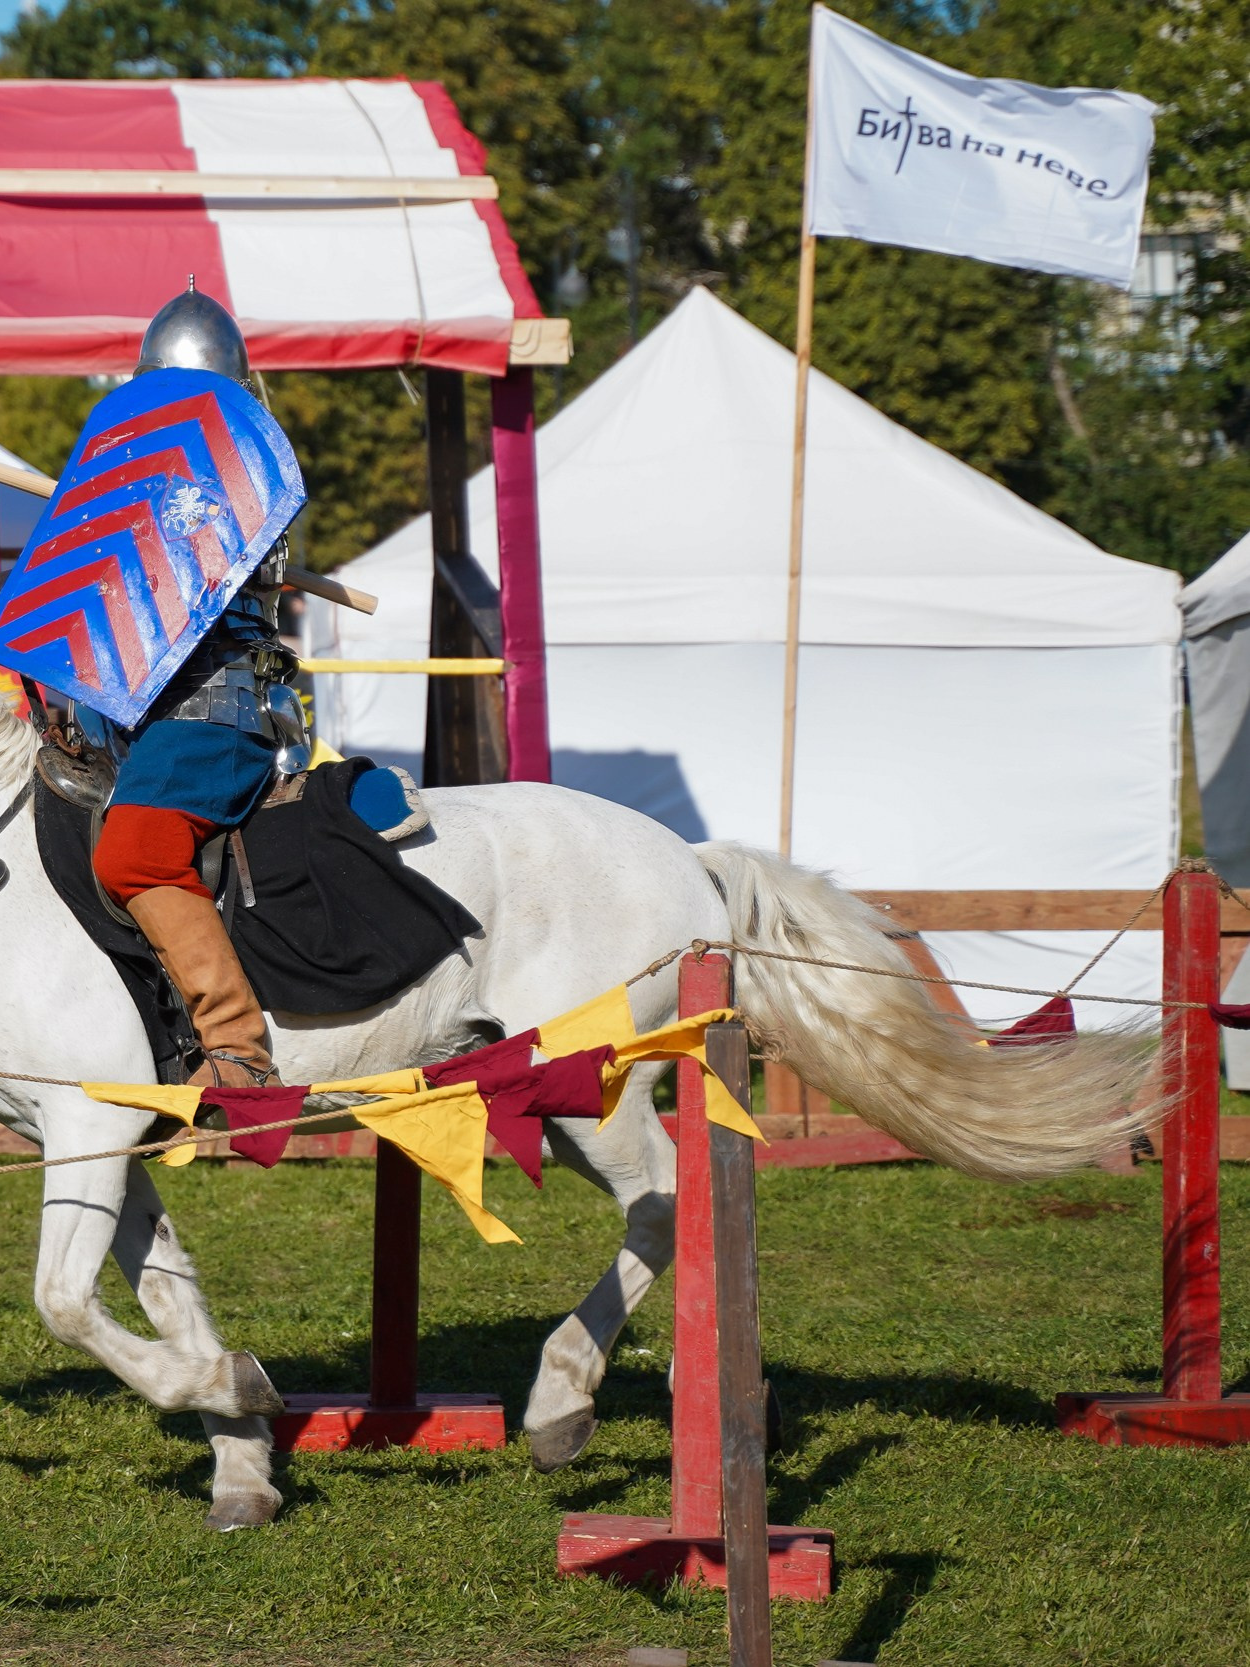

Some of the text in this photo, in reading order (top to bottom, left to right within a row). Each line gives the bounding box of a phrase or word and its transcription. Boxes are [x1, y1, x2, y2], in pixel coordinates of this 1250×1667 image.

[857, 96, 1108, 197] Битва на Неве
